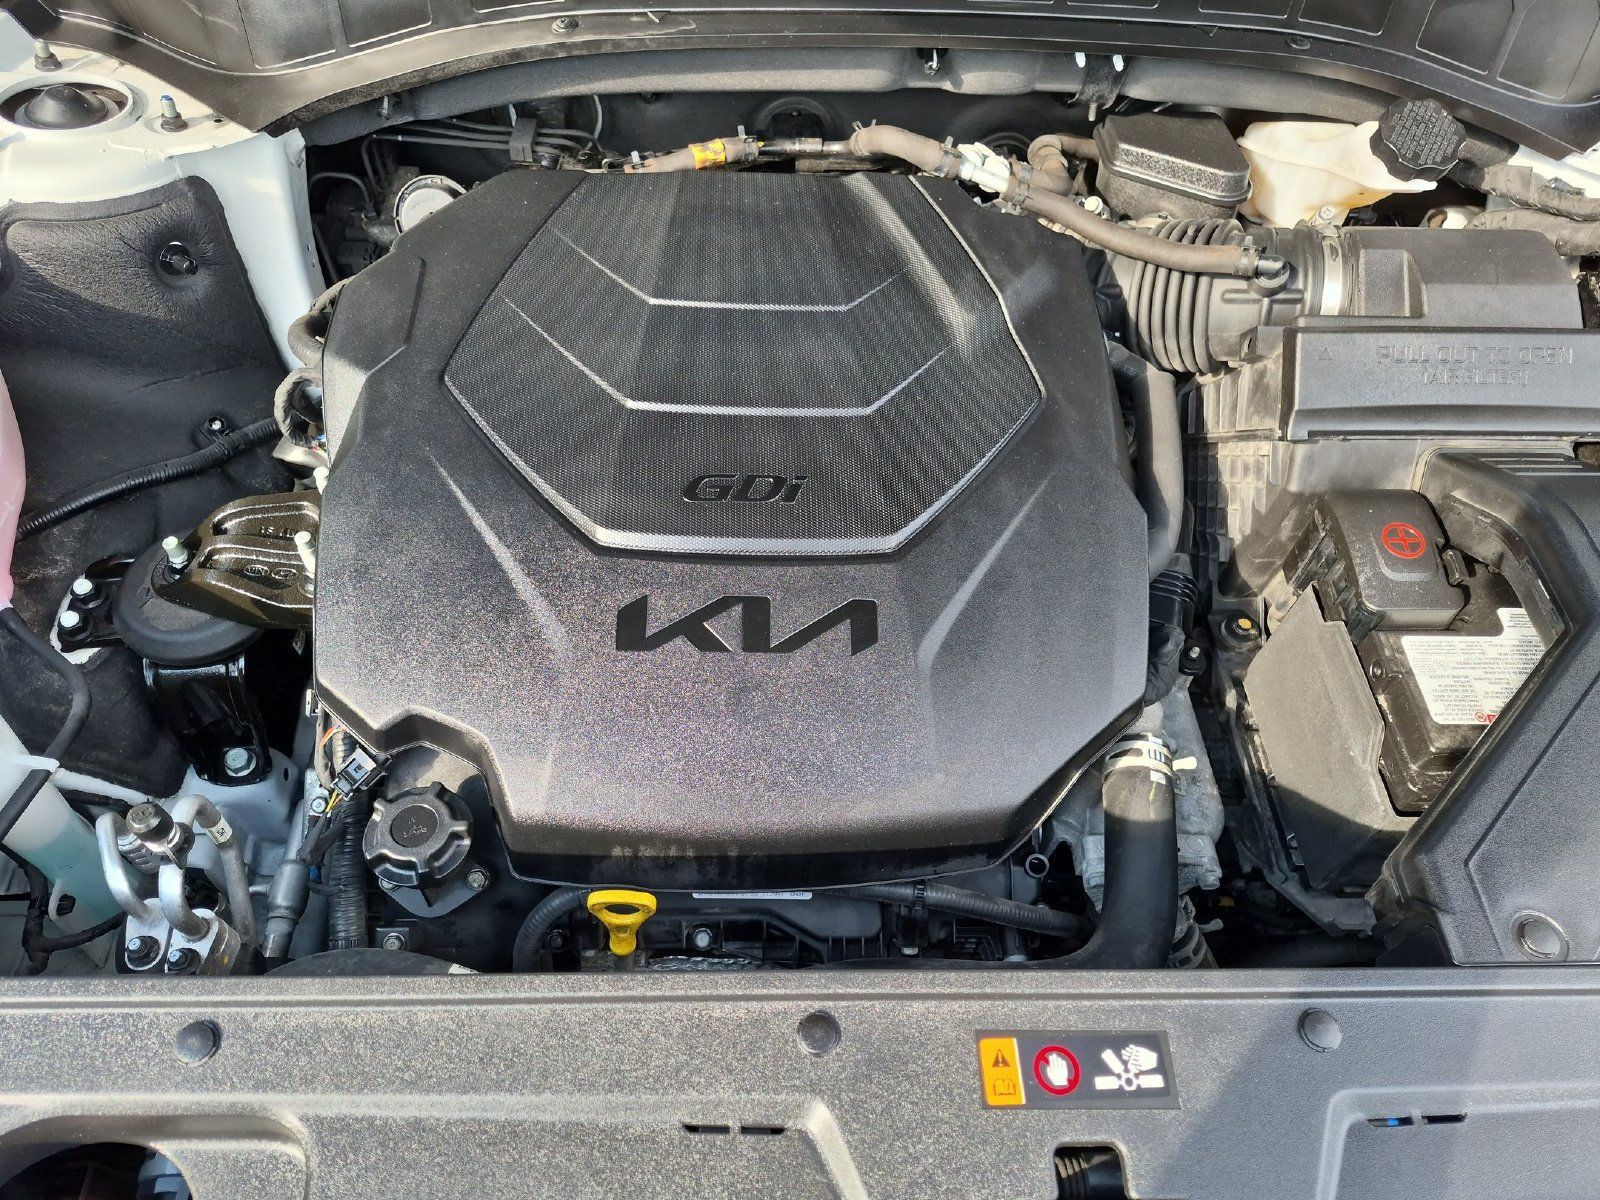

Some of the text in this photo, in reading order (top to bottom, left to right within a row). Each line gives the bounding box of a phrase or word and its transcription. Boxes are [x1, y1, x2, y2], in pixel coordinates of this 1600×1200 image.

[1377, 345, 1573, 365] PULL OUT TO OPEN
[683, 474, 808, 504] GDi
[616, 594, 879, 657] KIA
